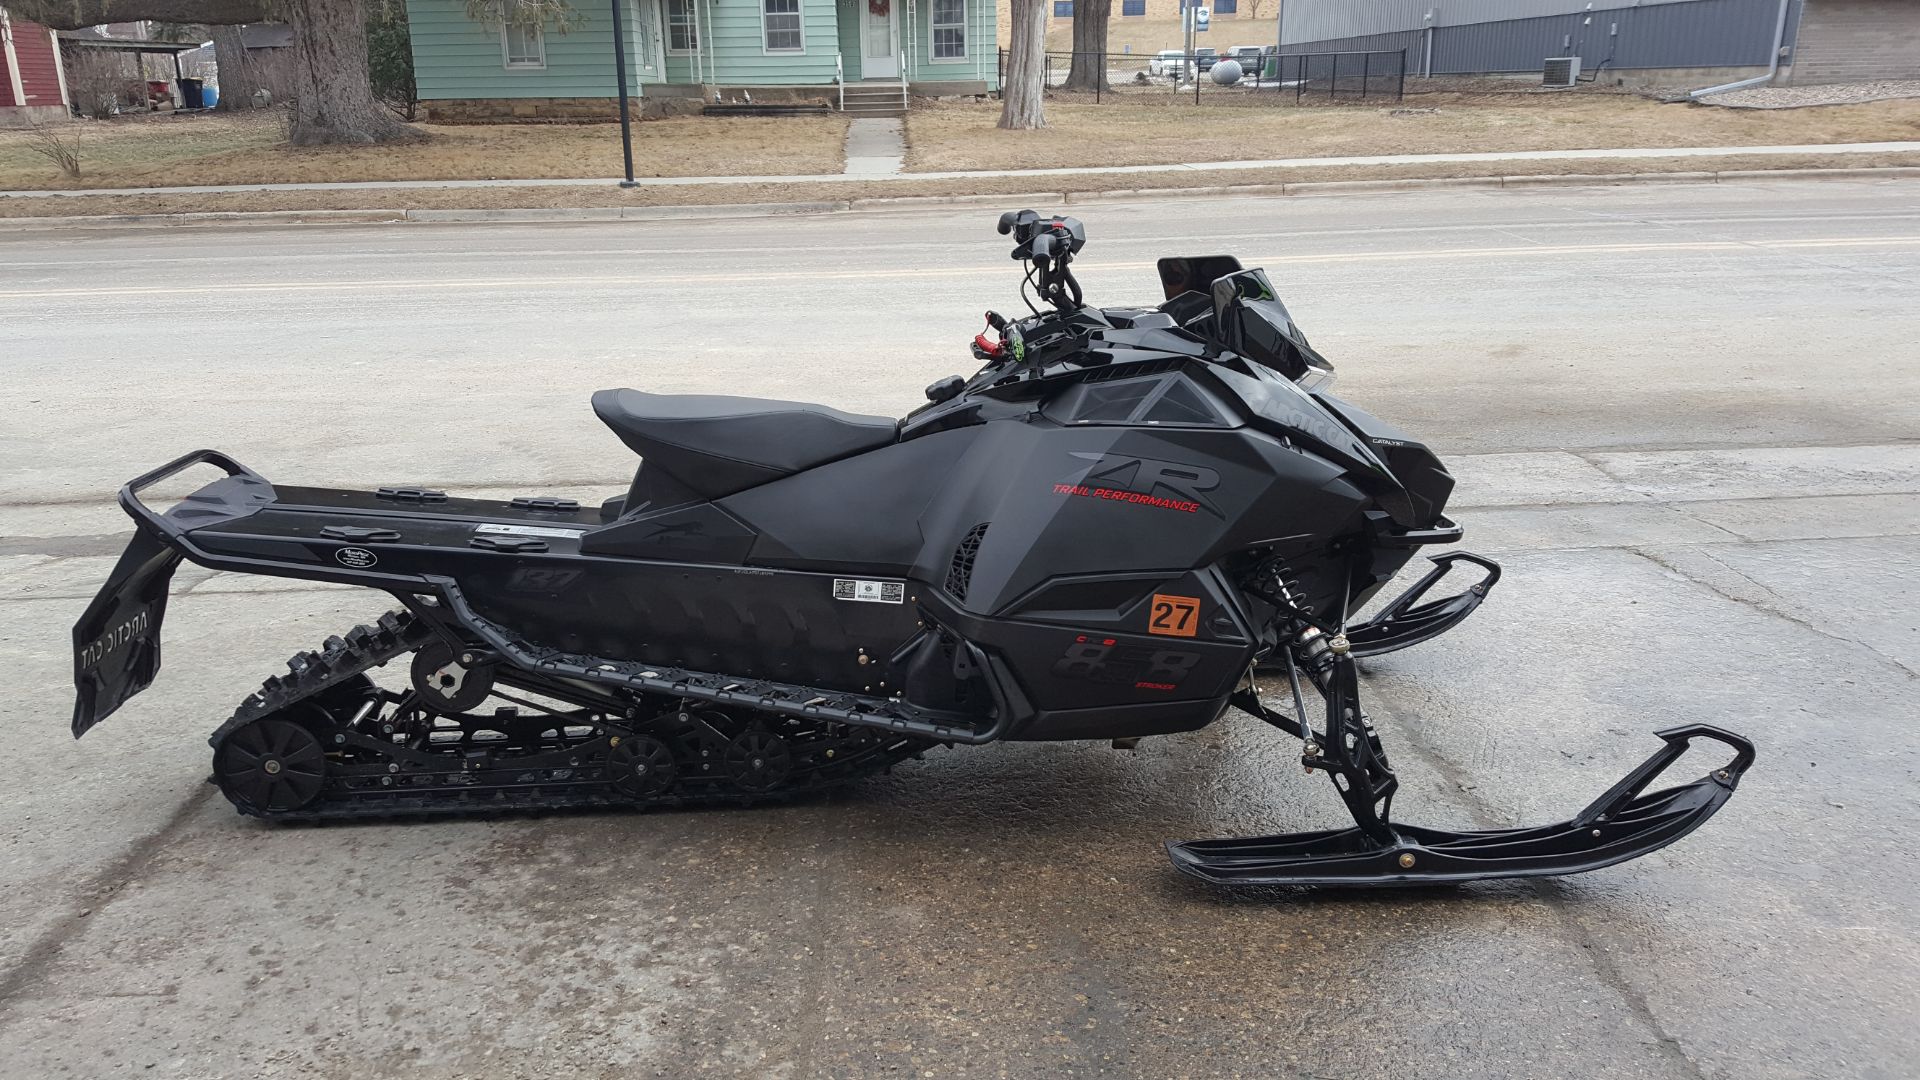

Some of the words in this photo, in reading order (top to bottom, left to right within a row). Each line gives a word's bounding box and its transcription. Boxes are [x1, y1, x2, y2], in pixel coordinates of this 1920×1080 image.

[1372, 438, 1404, 446] CATALYST
[1052, 483, 1089, 497] TRAIL
[1093, 488, 1201, 513] PERFORMANCE
[1152, 602, 1194, 630] 27
